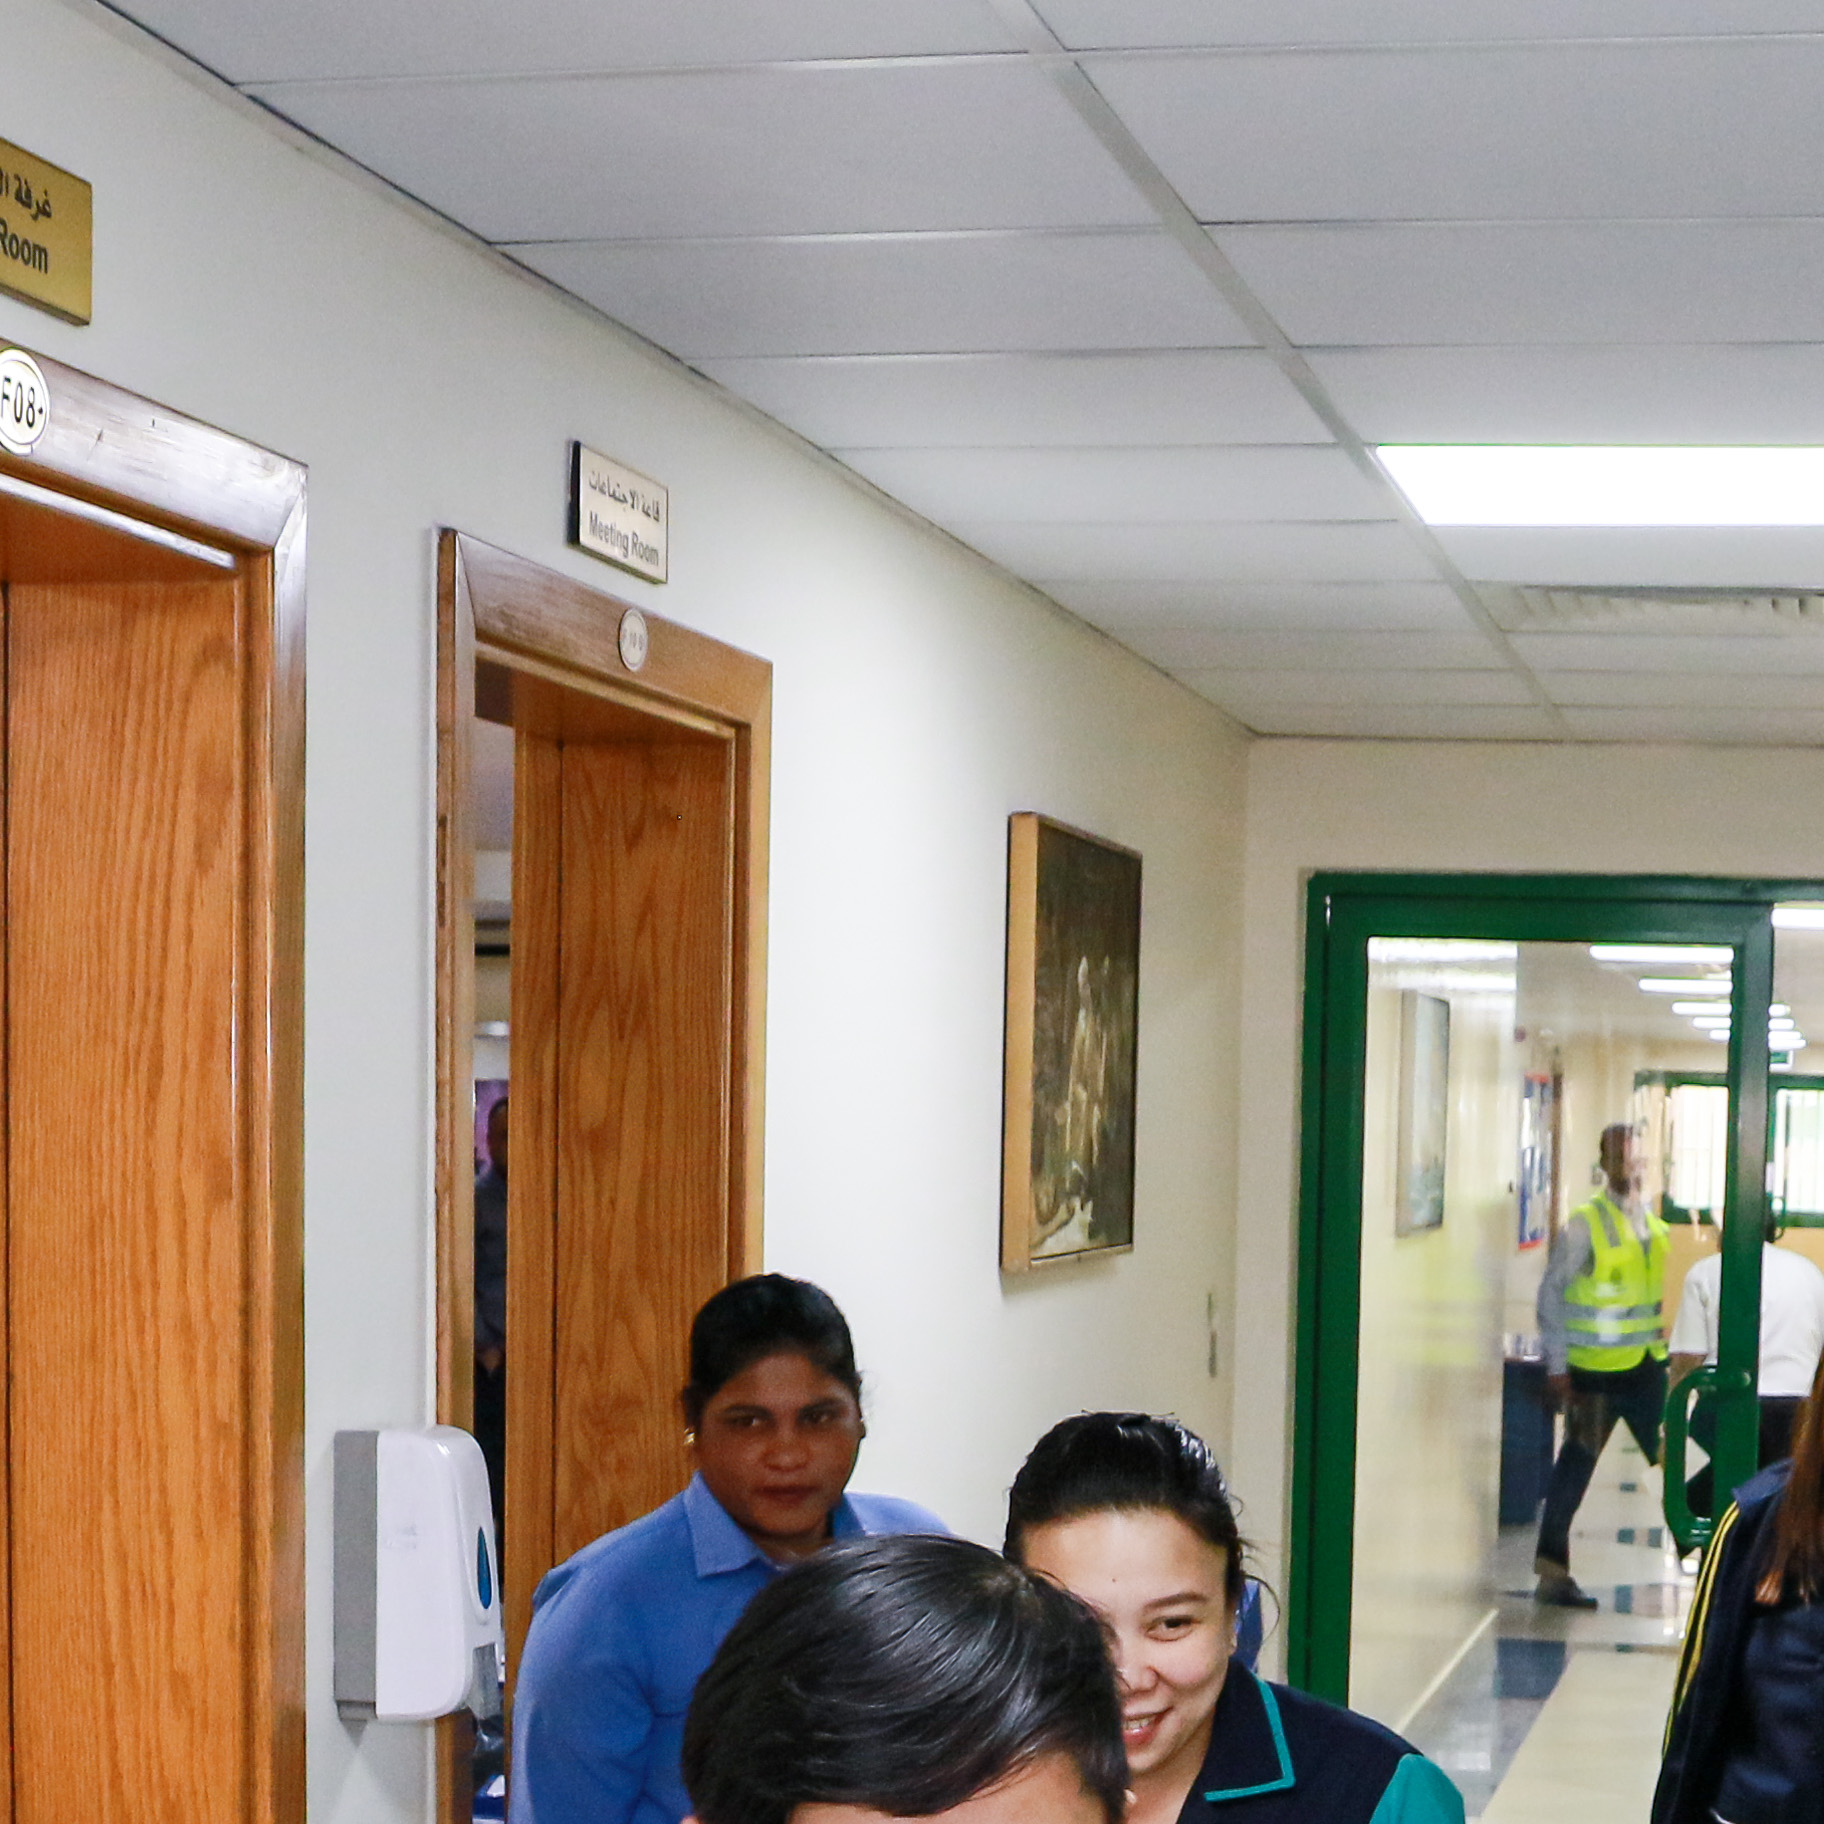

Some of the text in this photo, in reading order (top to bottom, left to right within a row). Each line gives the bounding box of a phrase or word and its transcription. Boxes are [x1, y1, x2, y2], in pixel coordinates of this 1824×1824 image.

[0, 376, 36, 428] F08
[589, 510, 659, 566] Meeting Room
